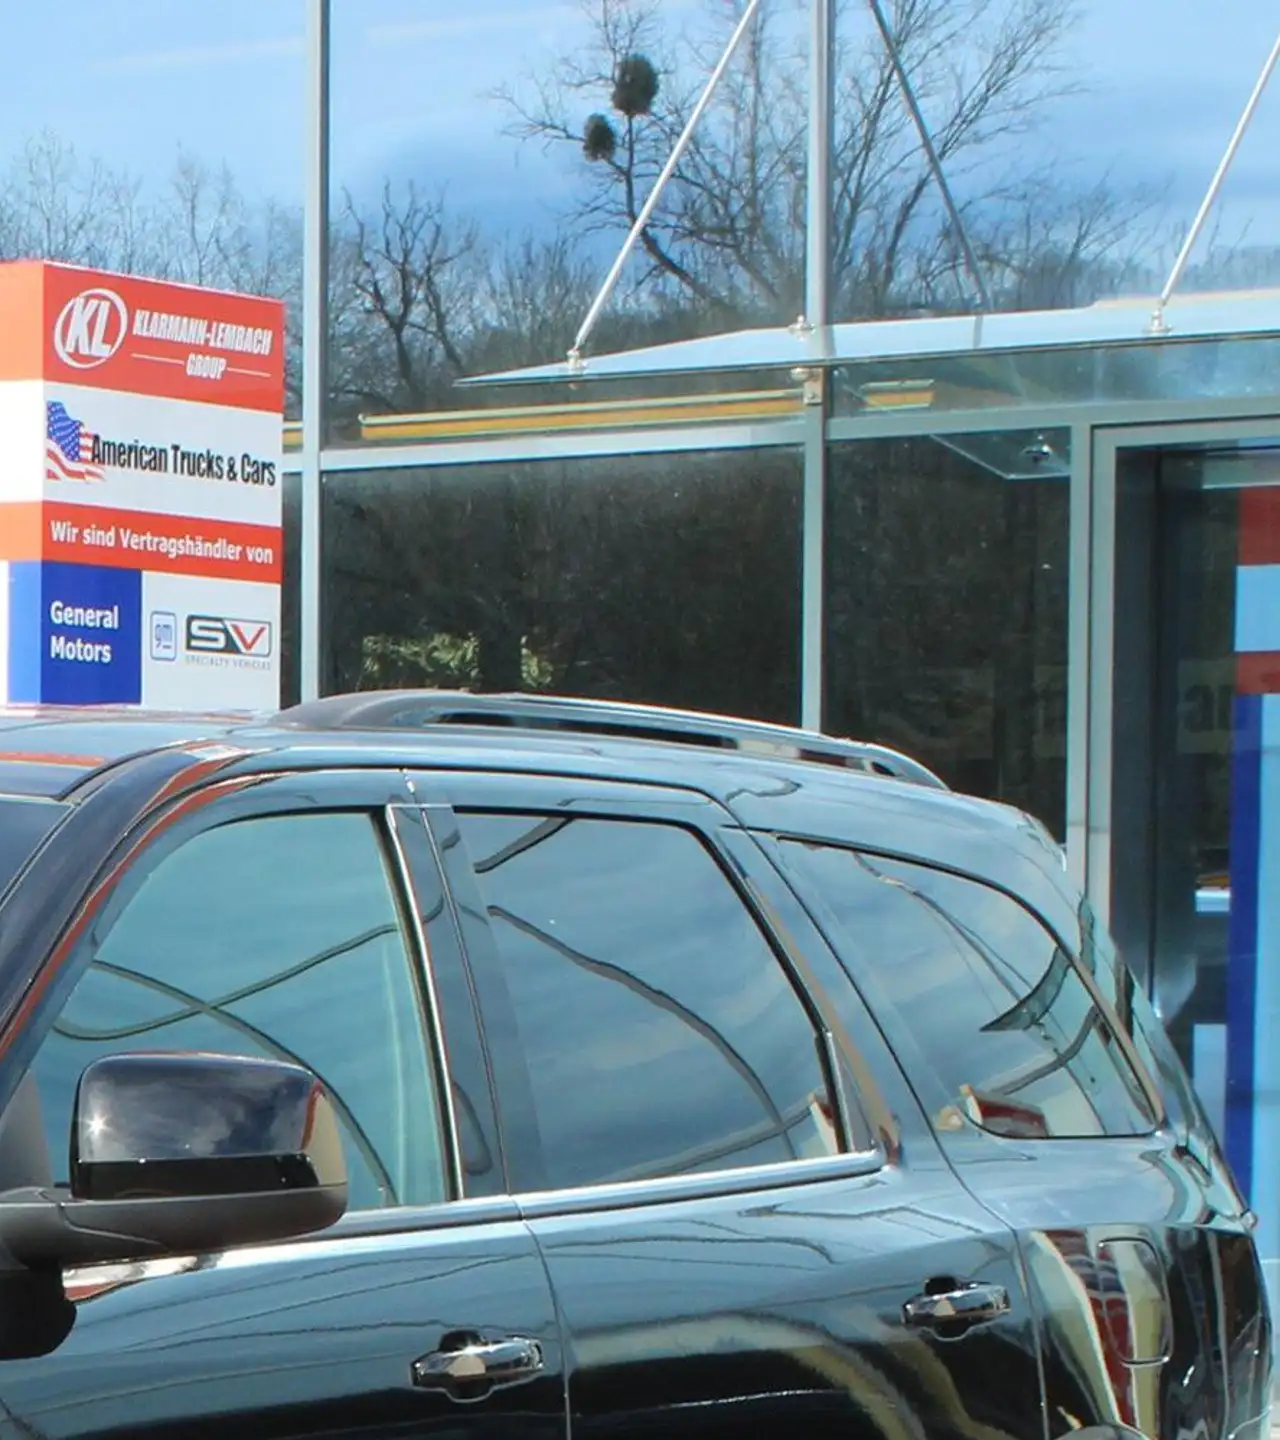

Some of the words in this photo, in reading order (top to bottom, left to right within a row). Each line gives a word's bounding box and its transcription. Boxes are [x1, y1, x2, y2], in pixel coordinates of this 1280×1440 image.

[65, 297, 113, 358] KL
[131, 308, 273, 356] KLARMANN-LEMBACH
[185, 351, 228, 380] GROUP
[91, 434, 168, 471] American
[171, 443, 224, 481] Trucks
[226, 456, 238, 481] &
[240, 453, 276, 487] Cars
[50, 519, 78, 543] Wir
[82, 525, 116, 547] sind
[119, 527, 242, 560] Vertragshändler
[246, 545, 273, 564] von
[50, 600, 119, 629] General
[50, 635, 112, 664] Motors
